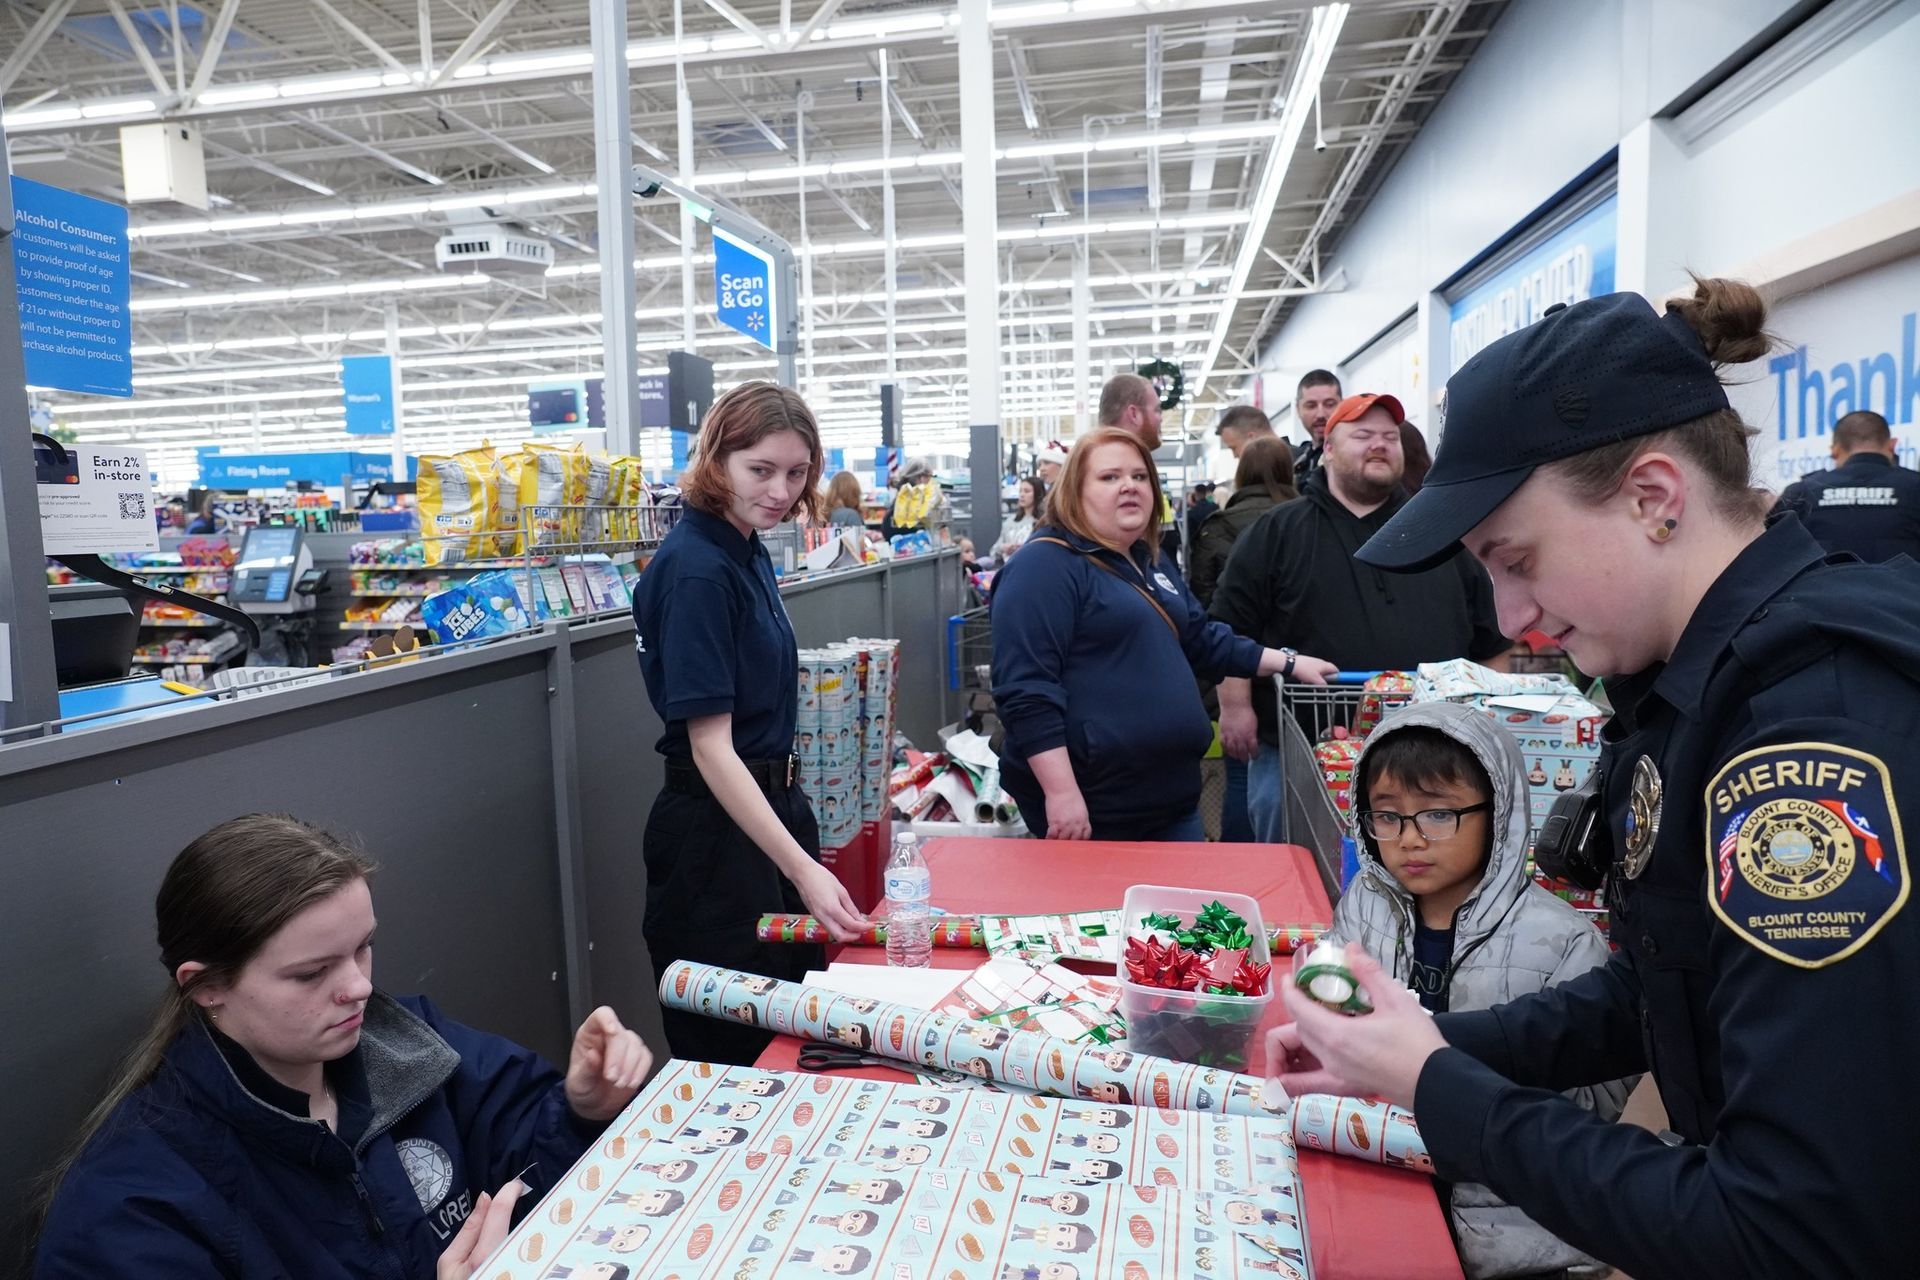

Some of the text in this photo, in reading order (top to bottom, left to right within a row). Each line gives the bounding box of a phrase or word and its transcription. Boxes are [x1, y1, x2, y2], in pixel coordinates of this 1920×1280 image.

[16, 210, 116, 245] Alcohol Consumer:
[23, 232, 68, 249] customers
[69, 244, 84, 254] will
[85, 246, 96, 257] be
[98, 250, 120, 262] asked
[18, 249, 113, 278] to provide proof of age
[21, 266, 112, 294] by showing proper ID.
[721, 274, 763, 290] Scan
[64, 294, 89, 306] under
[90, 298, 103, 309] the
[104, 303, 120, 314] age
[26, 304, 36, 314] 21
[49, 309, 82, 322] without
[84, 316, 111, 327] proper
[112, 320, 121, 328] ID
[20, 322, 116, 344] will not be permitted to
[22, 340, 124, 362] urchase alcohol products.
[638, 379, 653, 389] ack
[93, 456, 140, 468] Earn 2%
[227, 465, 290, 478] Fitting Rooms
[94, 470, 141, 481] in-store
[1822, 487, 1895, 499] SHERIFF
[447, 610, 466, 631] ICE
[453, 608, 486, 640] CUBES
[1715, 760, 1867, 814] SHERIFF
[1741, 801, 1843, 839] BLOUNT COUNTY
[1764, 822, 1817, 842] STATE OF
[1763, 848, 1824, 876] TENNESSEE
[1743, 856, 1851, 897] SHERIFF'S OFFICE
[1748, 912, 1866, 927] BLOUNT COUNTY
[1764, 927, 1851, 939] TENNESSEE
[438, 1161, 453, 1200] OFFICE
